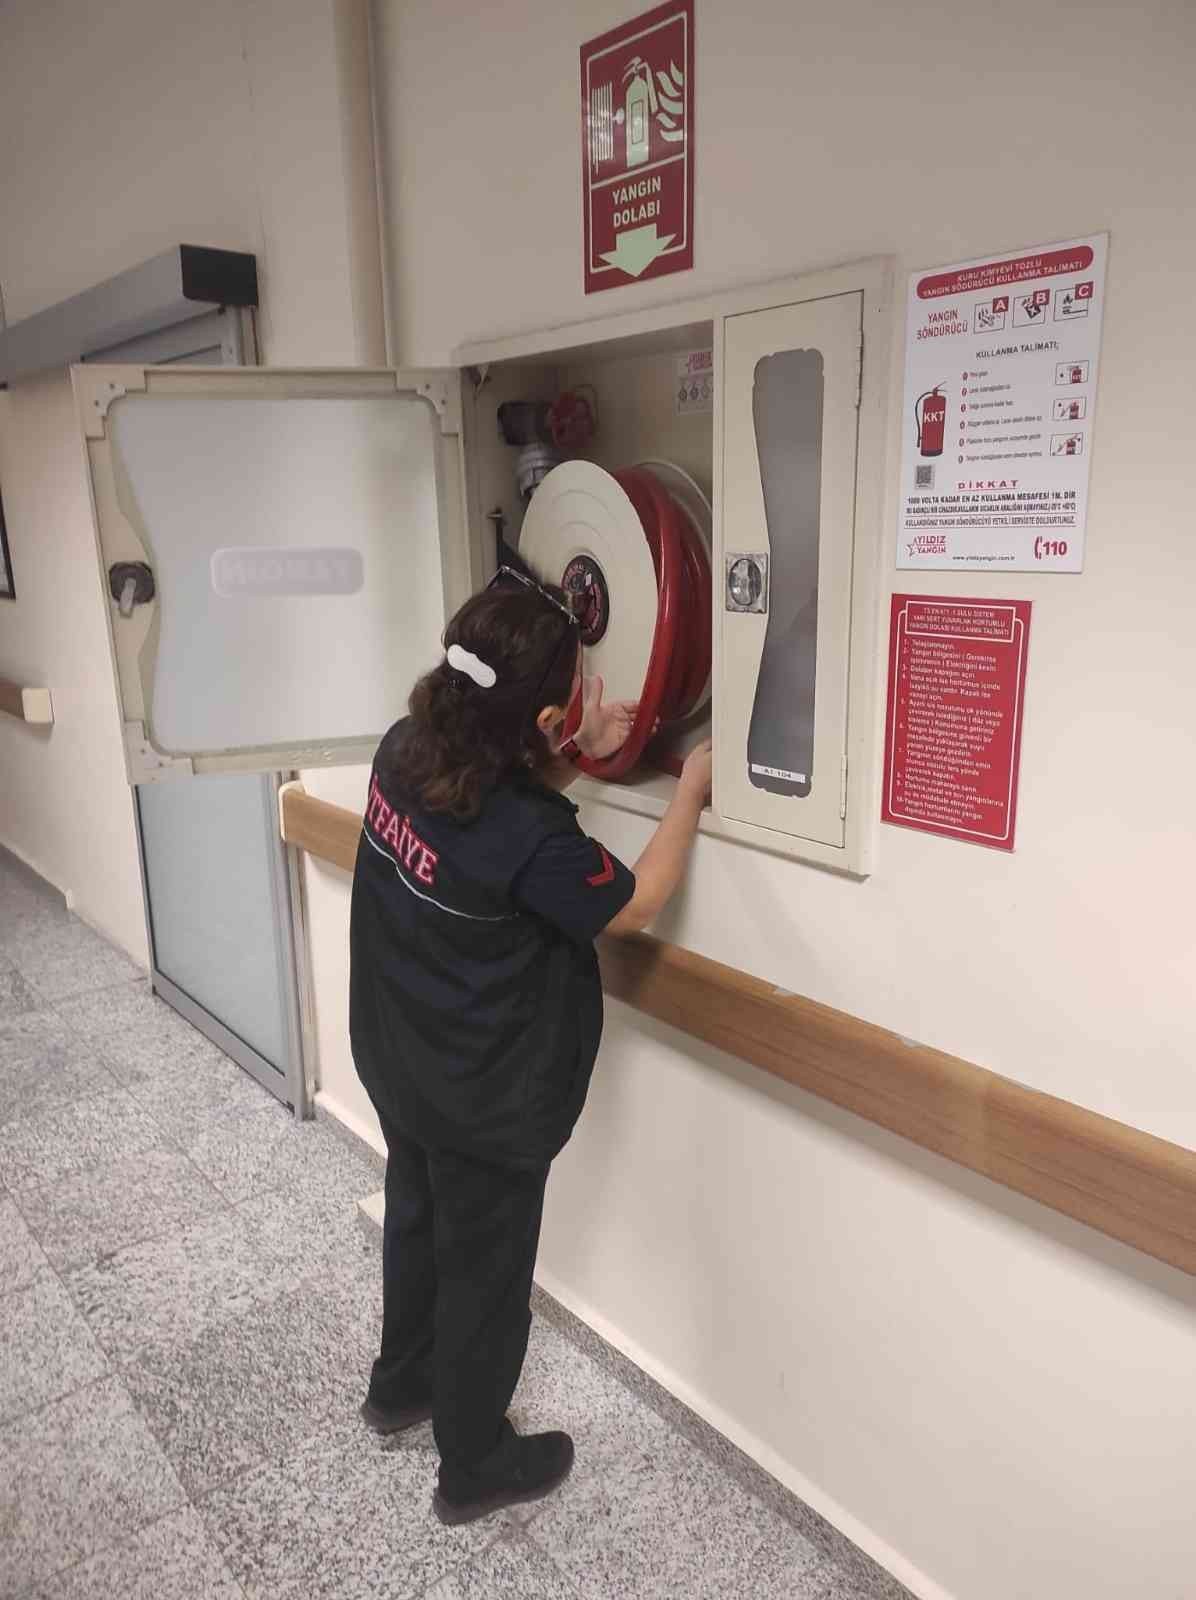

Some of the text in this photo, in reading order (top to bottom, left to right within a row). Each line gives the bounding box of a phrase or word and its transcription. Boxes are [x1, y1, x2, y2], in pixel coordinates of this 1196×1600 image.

[612, 176, 662, 205] YANGIN
[613, 199, 661, 228] DOLABI
[996, 270, 1041, 284] KULLANMA
[1042, 261, 1083, 275] TALİMATI
[1078, 285, 1090, 297] C
[1035, 292, 1047, 304] B
[995, 299, 1007, 311] A
[927, 308, 958, 321] YANGIN
[917, 320, 968, 340] SÖNDÜRÜCÜ
[976, 346, 1018, 359] KULLANMA
[923, 410, 945, 423] KKT
[958, 479, 1019, 490] DİKKAT
[941, 495, 961, 503] KADAR
[981, 493, 1015, 502] KULLANMA
[917, 535, 946, 544] YILDIZ
[1043, 541, 1067, 556] 110
